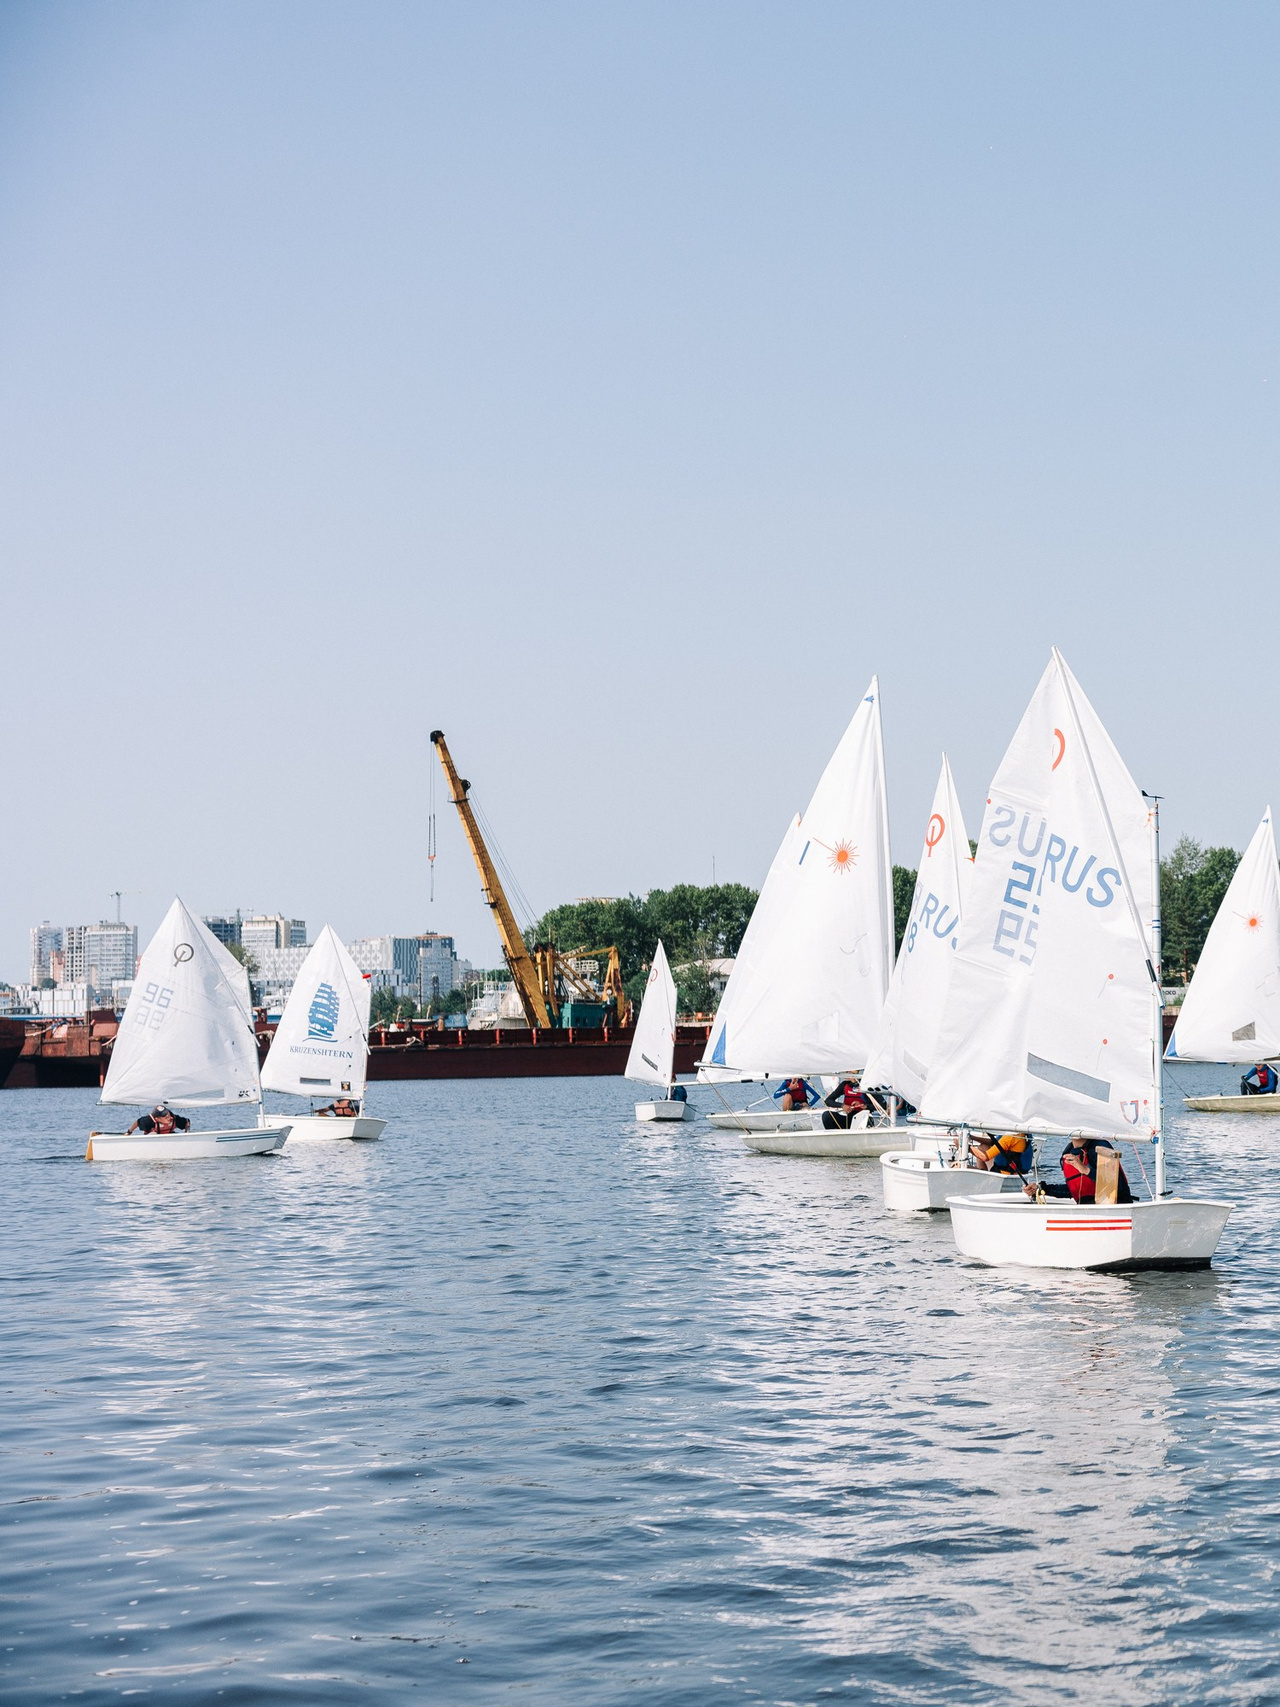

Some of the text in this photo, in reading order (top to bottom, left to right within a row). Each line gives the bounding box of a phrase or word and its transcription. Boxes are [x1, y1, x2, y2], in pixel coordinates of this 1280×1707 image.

[1042, 833, 1122, 908] RUS
[143, 982, 174, 1009] 96
[289, 1045, 354, 1059] KRUZENSHTERN
